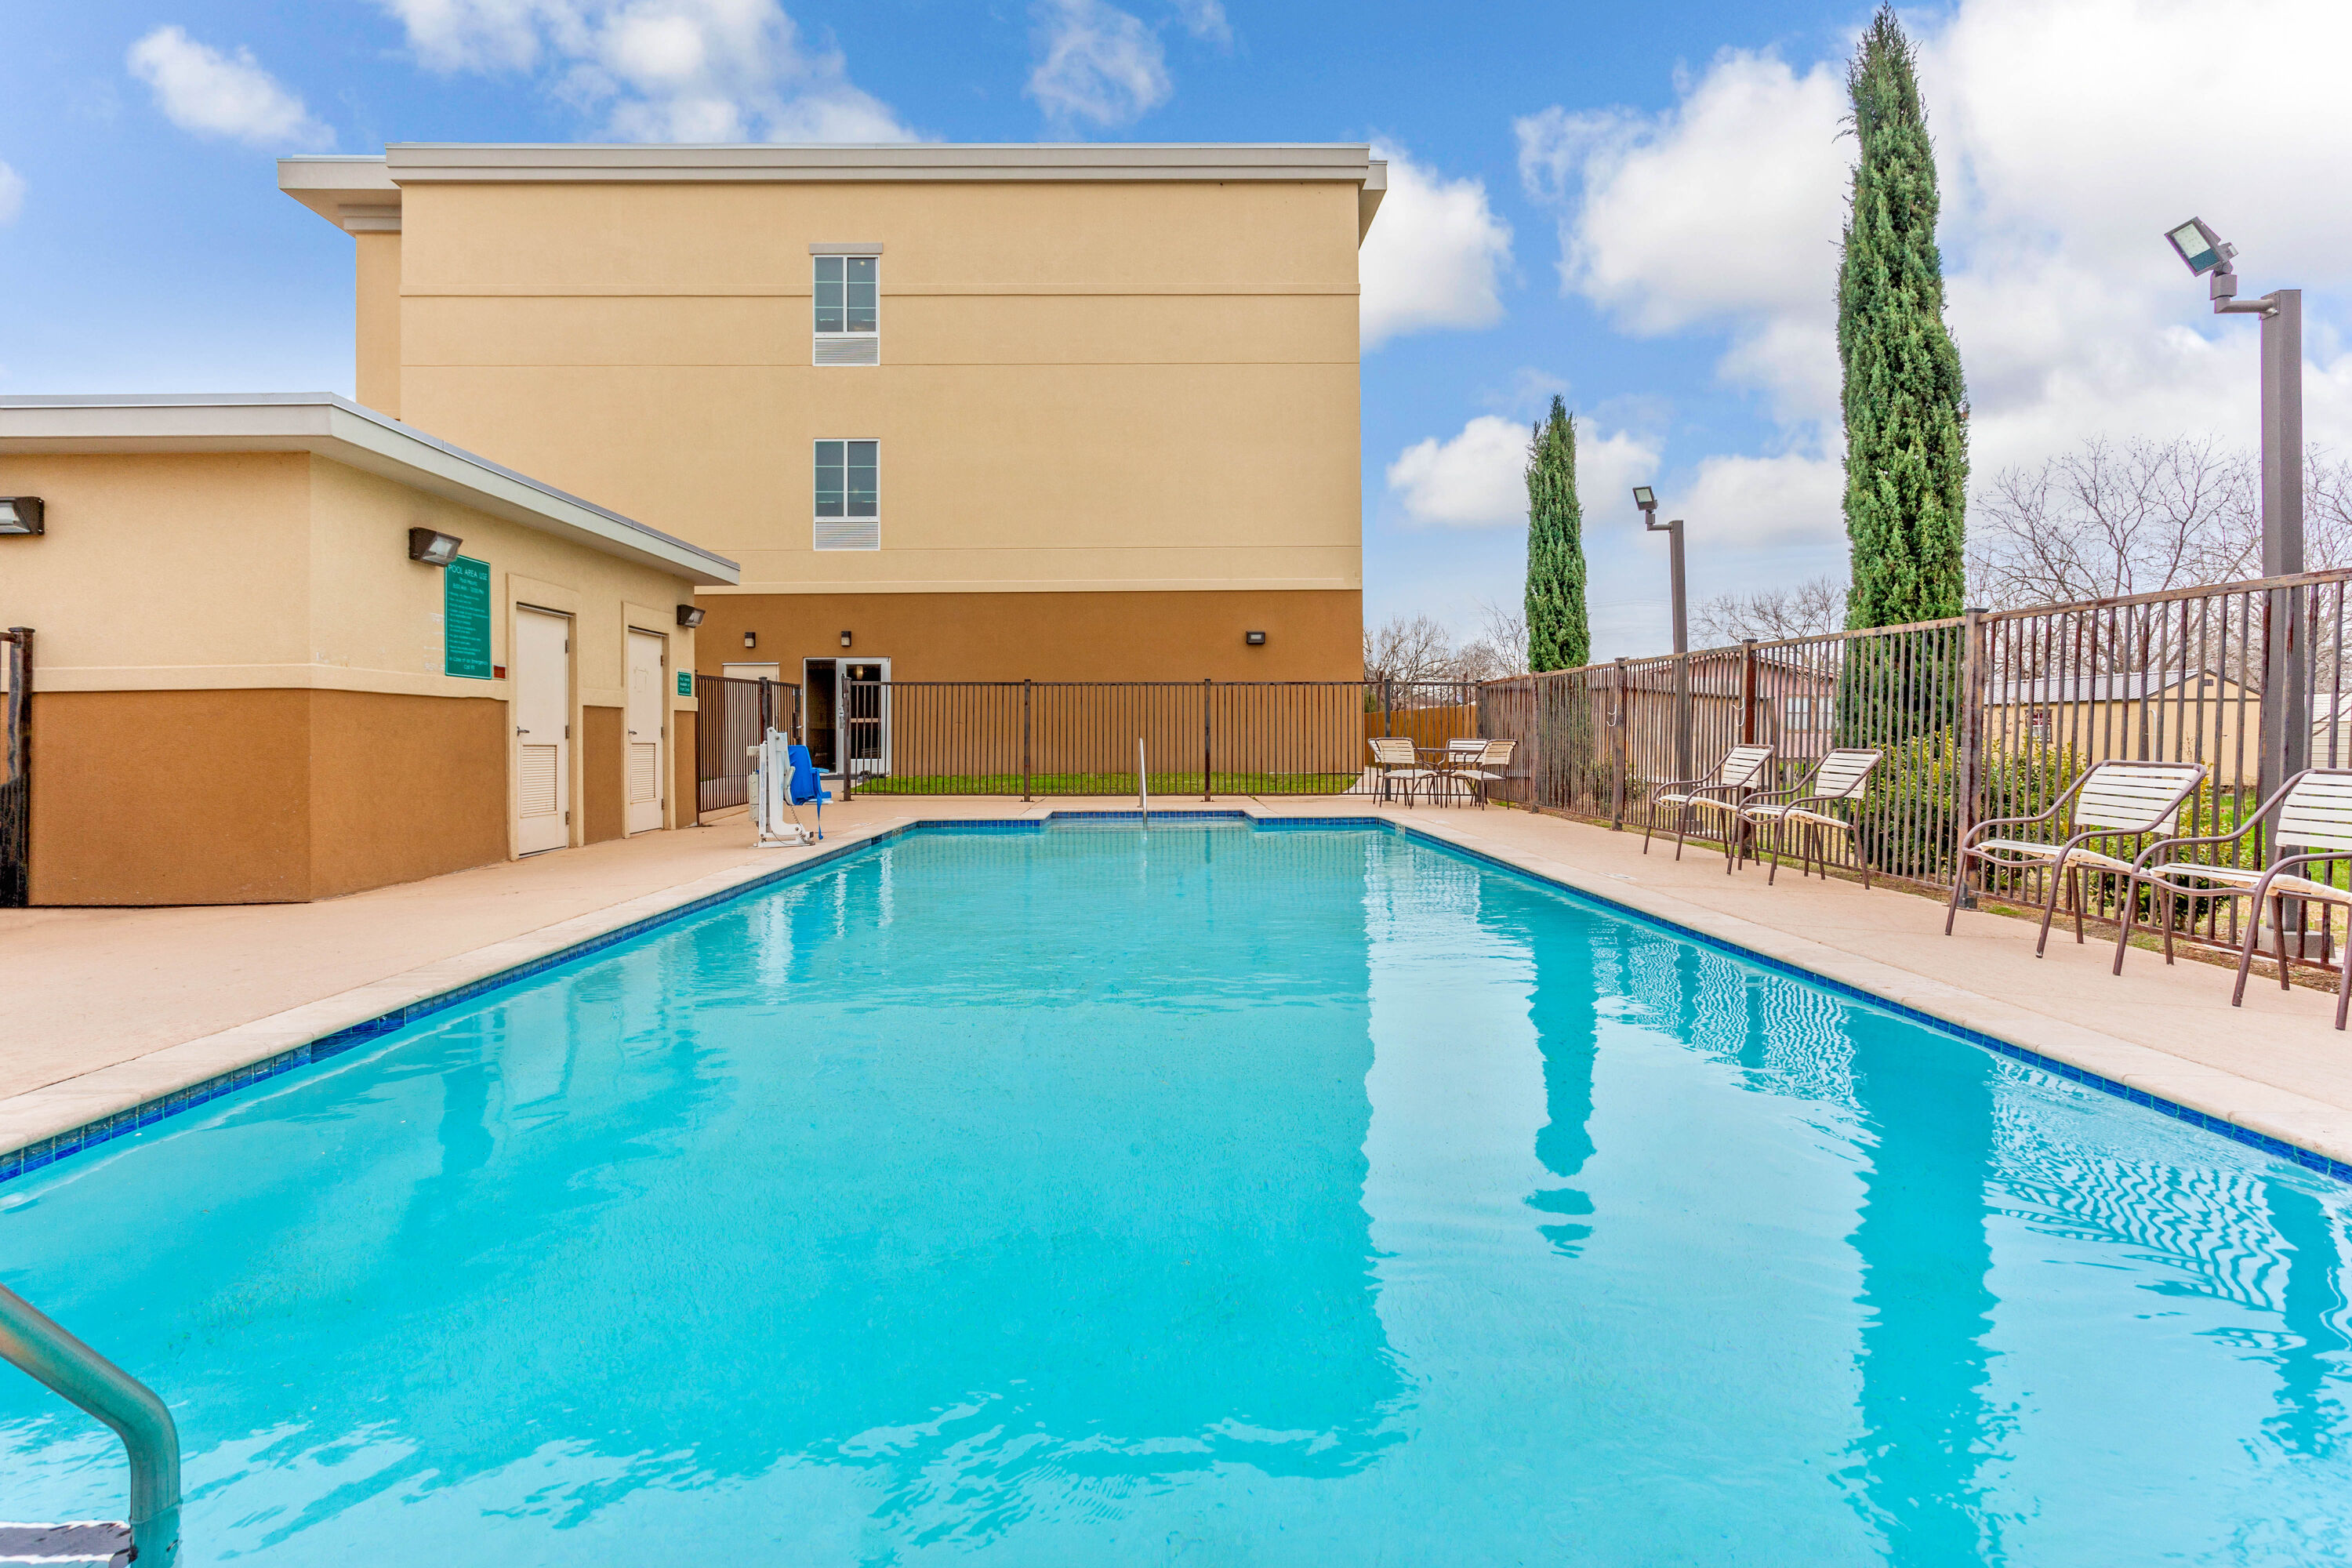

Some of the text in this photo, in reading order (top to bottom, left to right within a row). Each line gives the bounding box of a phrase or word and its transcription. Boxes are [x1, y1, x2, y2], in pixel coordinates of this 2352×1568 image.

[448, 564, 488, 581] POOL AREA USE
